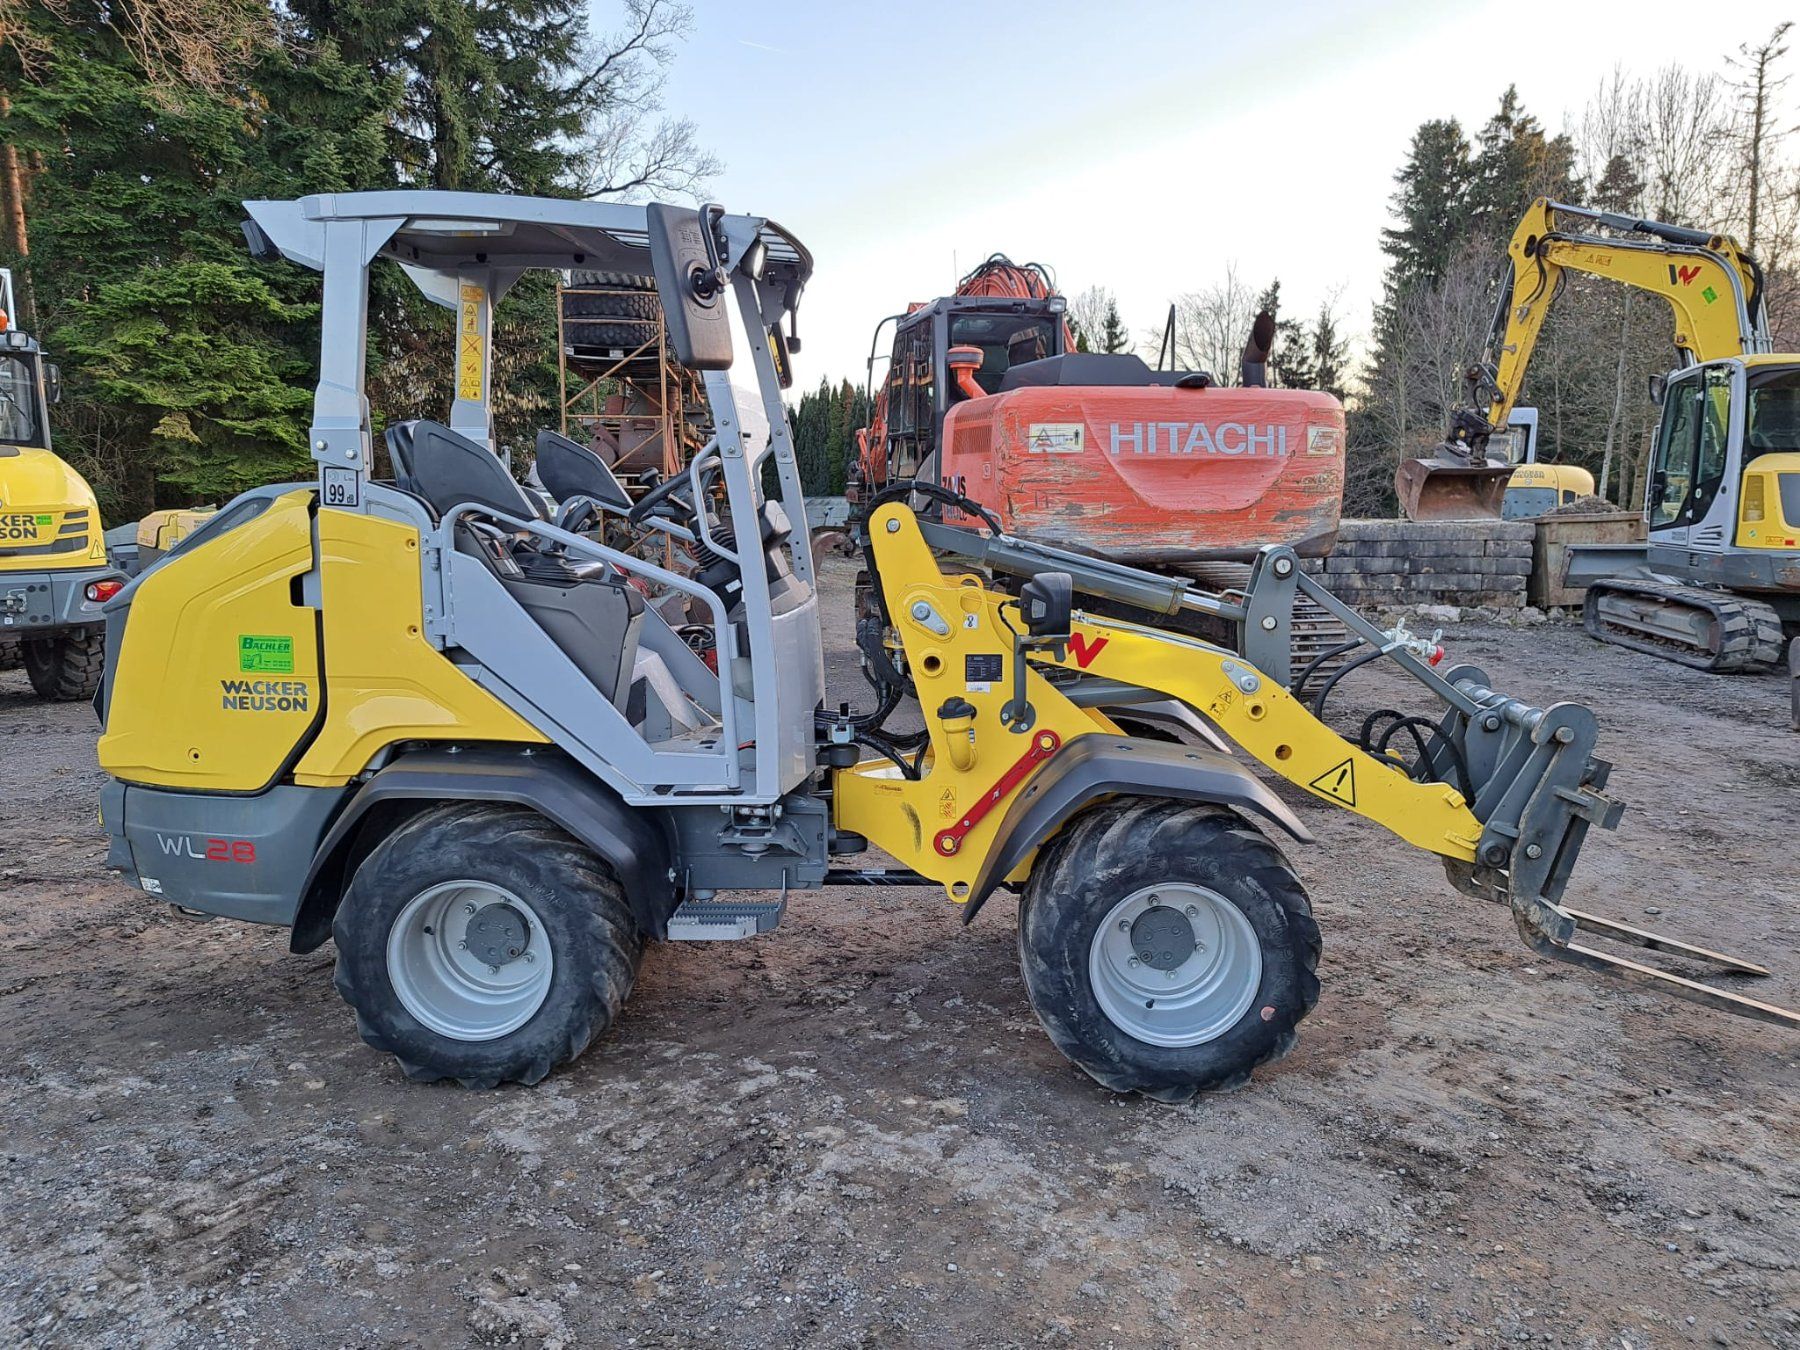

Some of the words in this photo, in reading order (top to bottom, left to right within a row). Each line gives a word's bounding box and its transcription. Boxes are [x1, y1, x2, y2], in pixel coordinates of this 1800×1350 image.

[1110, 422, 1286, 456] HITACHI
[329, 484, 344, 502] 99
[221, 680, 308, 696] WACKER
[222, 696, 308, 711] NEUSON
